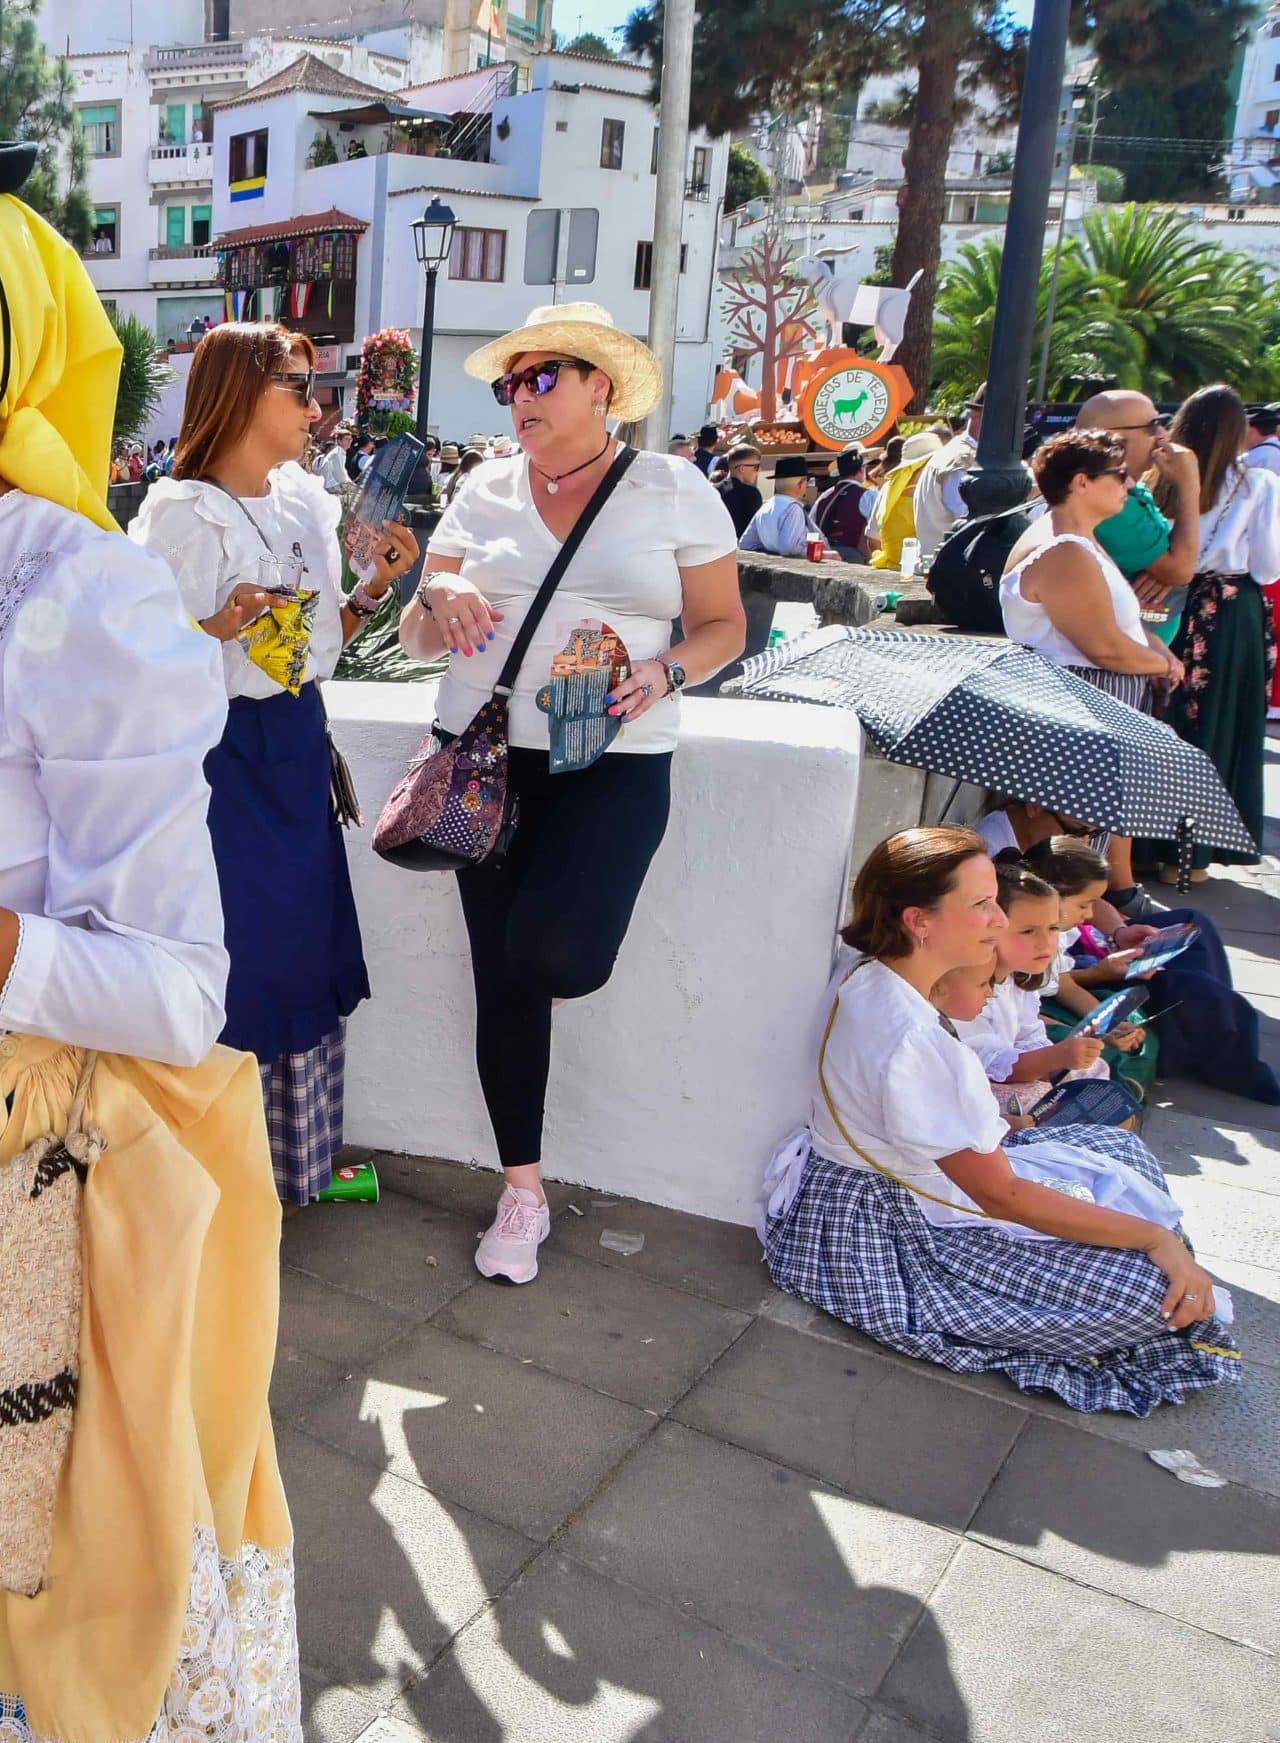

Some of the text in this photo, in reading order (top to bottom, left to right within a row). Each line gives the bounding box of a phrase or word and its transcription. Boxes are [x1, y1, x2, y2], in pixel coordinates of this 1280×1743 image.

[816, 371, 887, 425] QUESOS DE TEJEDA
